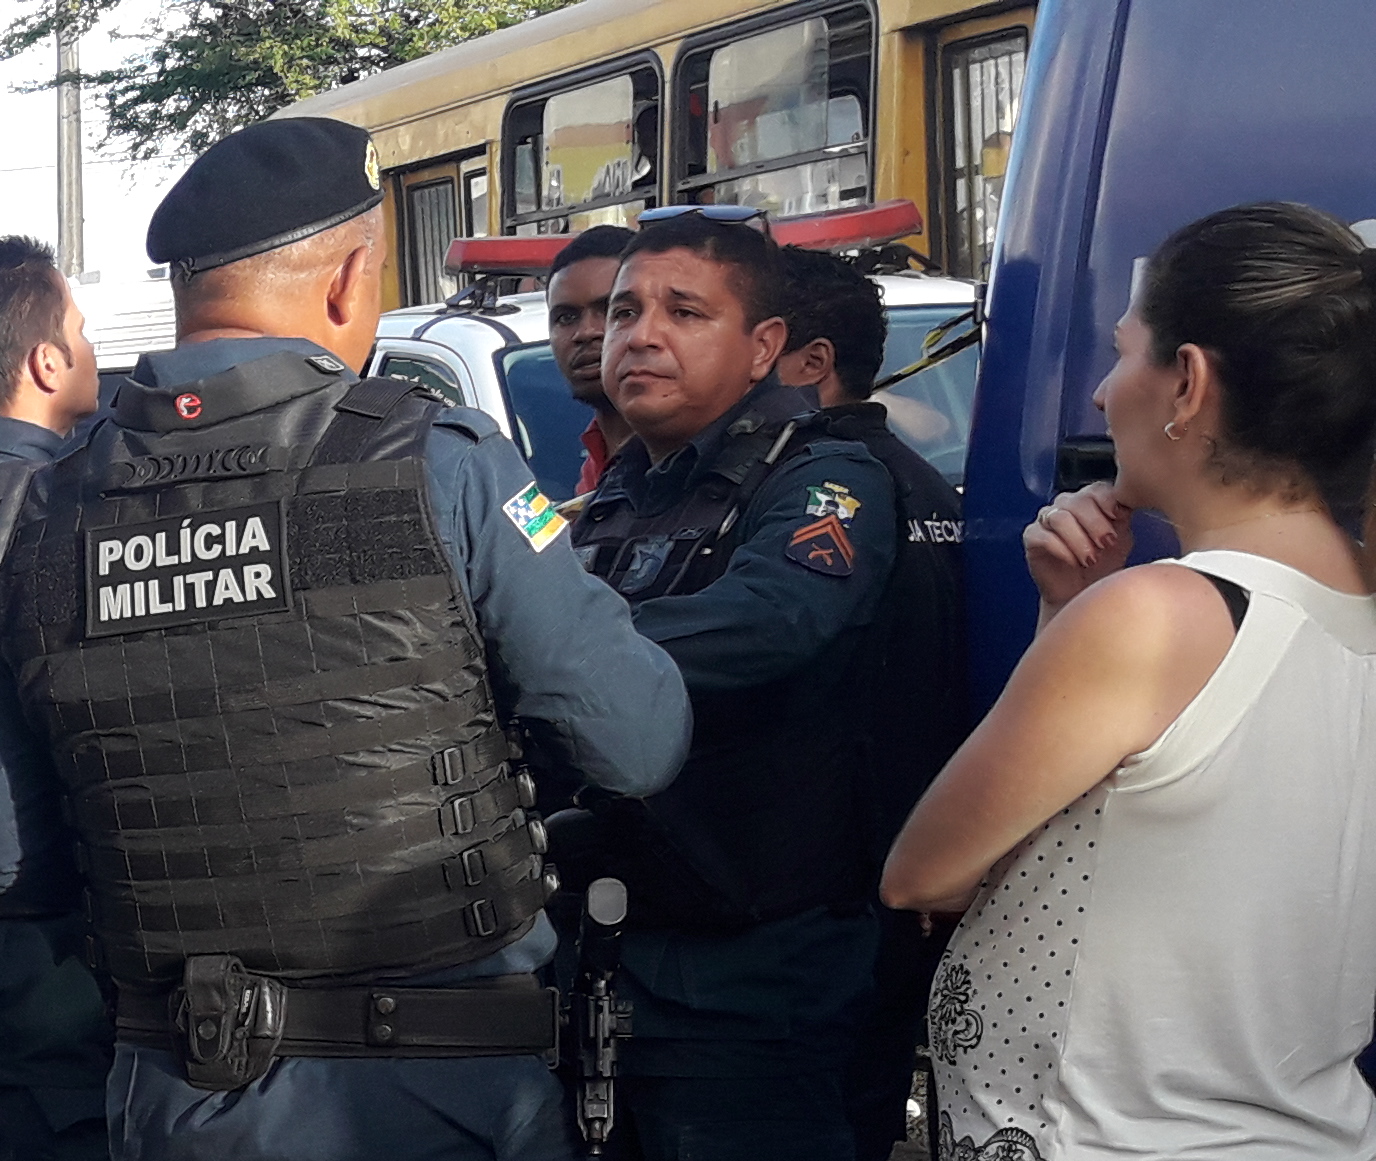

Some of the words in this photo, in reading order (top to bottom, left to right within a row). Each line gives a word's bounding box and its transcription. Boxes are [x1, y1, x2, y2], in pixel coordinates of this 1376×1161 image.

[98, 516, 271, 576] POLÍCIA
[924, 512, 965, 544] TÉCN
[99, 563, 277, 622] MILITAR
